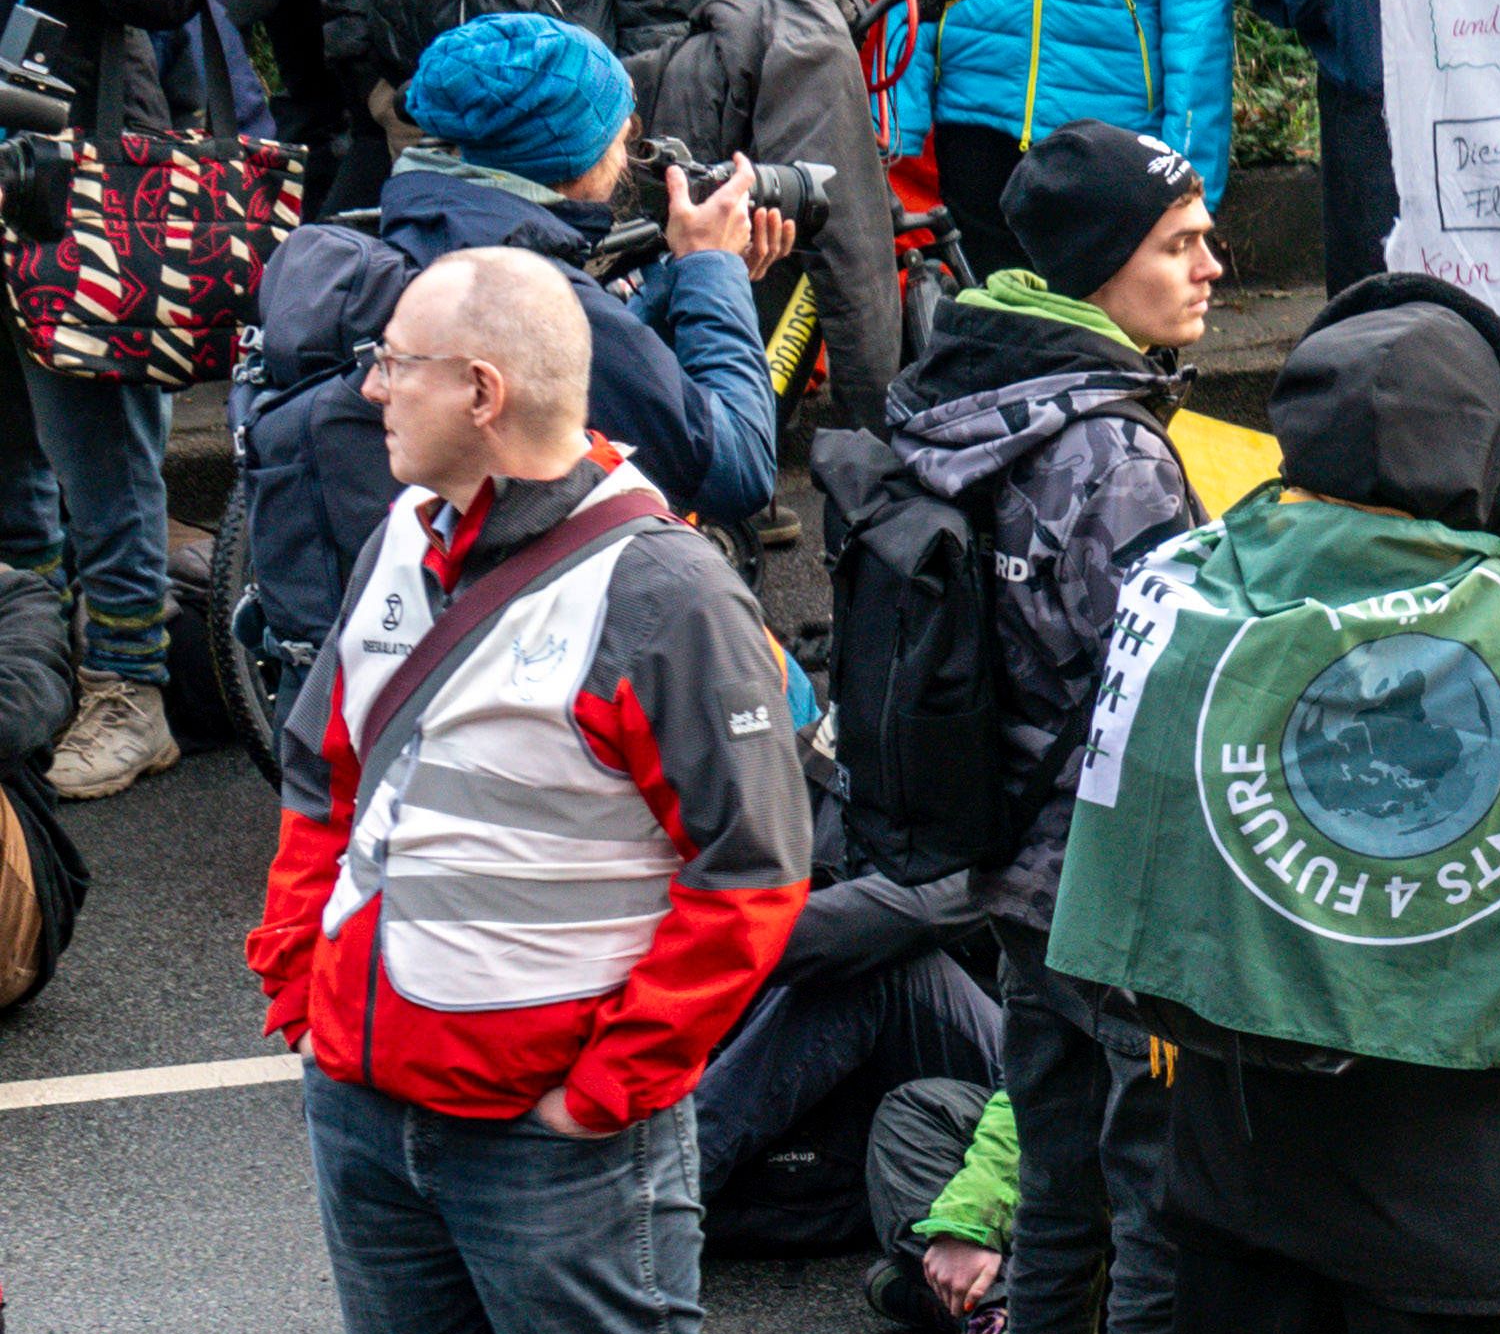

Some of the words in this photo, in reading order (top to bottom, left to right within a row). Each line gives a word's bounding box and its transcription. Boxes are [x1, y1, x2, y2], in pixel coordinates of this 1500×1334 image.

[1419, 246, 1498, 285] Kein
[1220, 742, 1370, 918] FUTURE
[1384, 875, 1420, 918] 4
